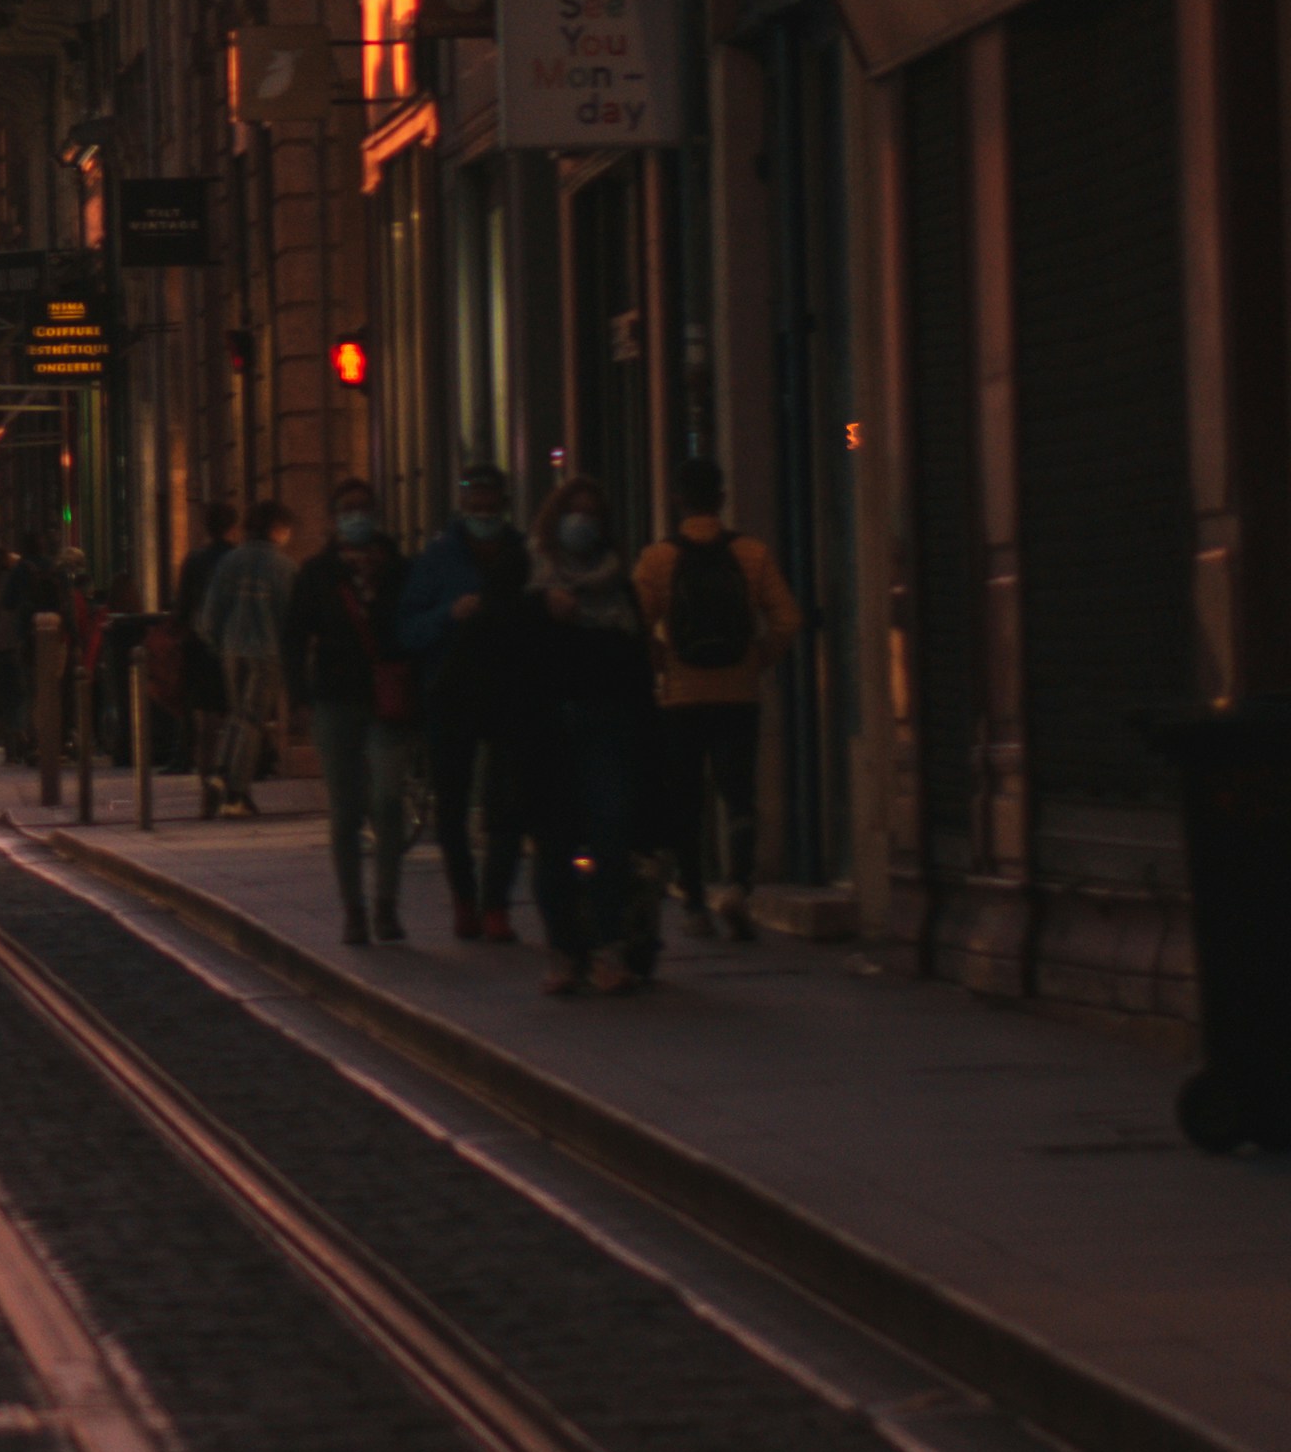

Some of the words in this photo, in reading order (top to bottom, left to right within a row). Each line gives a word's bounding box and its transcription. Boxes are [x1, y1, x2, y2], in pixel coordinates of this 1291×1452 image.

[561, 26, 626, 56] You
[577, 93, 645, 131] day
[32, 326, 102, 337] COIFFURE
